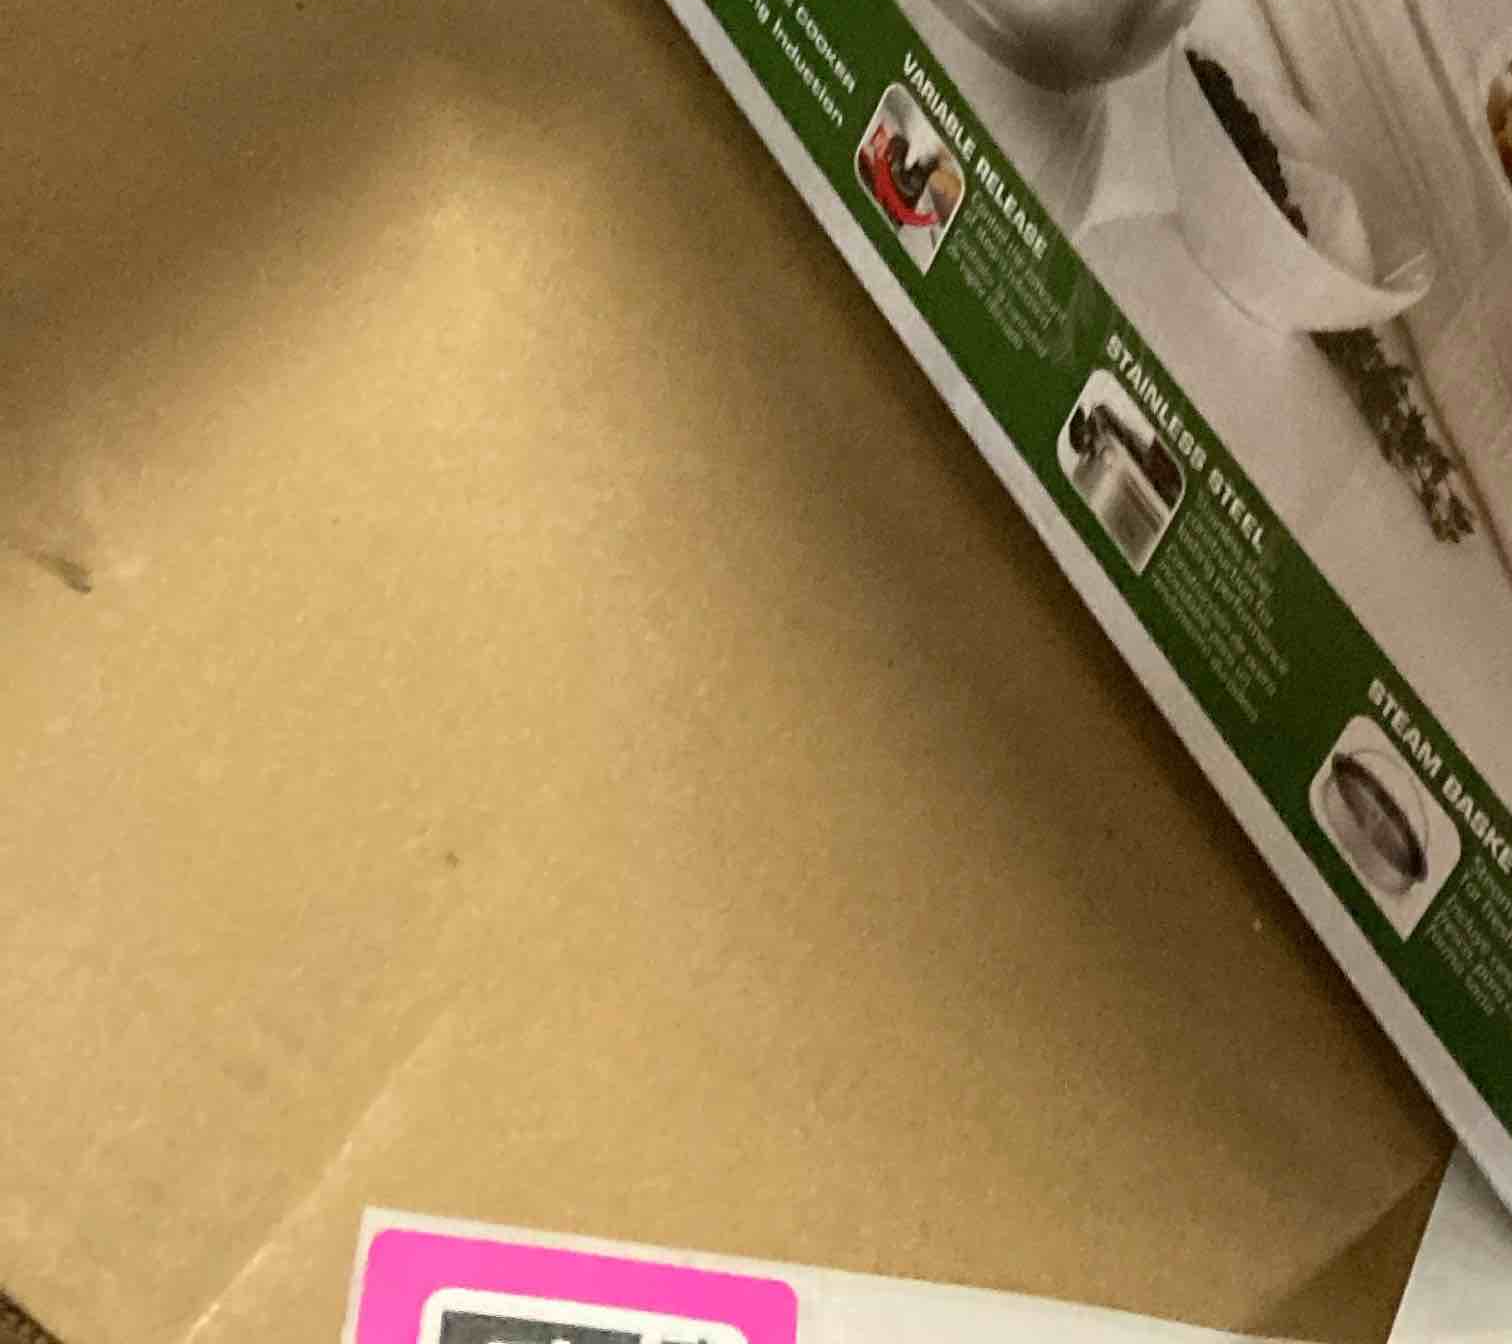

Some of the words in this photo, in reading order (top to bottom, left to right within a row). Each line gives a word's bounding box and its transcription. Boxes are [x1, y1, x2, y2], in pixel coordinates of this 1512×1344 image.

[772, 18, 843, 127] Induction
[795, 5, 855, 93] COOKER
[902, 52, 975, 161] VARIABLE
[973, 156, 1048, 261] RELEASE
[1105, 333, 1206, 472] STAINLESS
[1206, 468, 1261, 555] STEEL
[1367, 677, 1442, 778] STEAM
